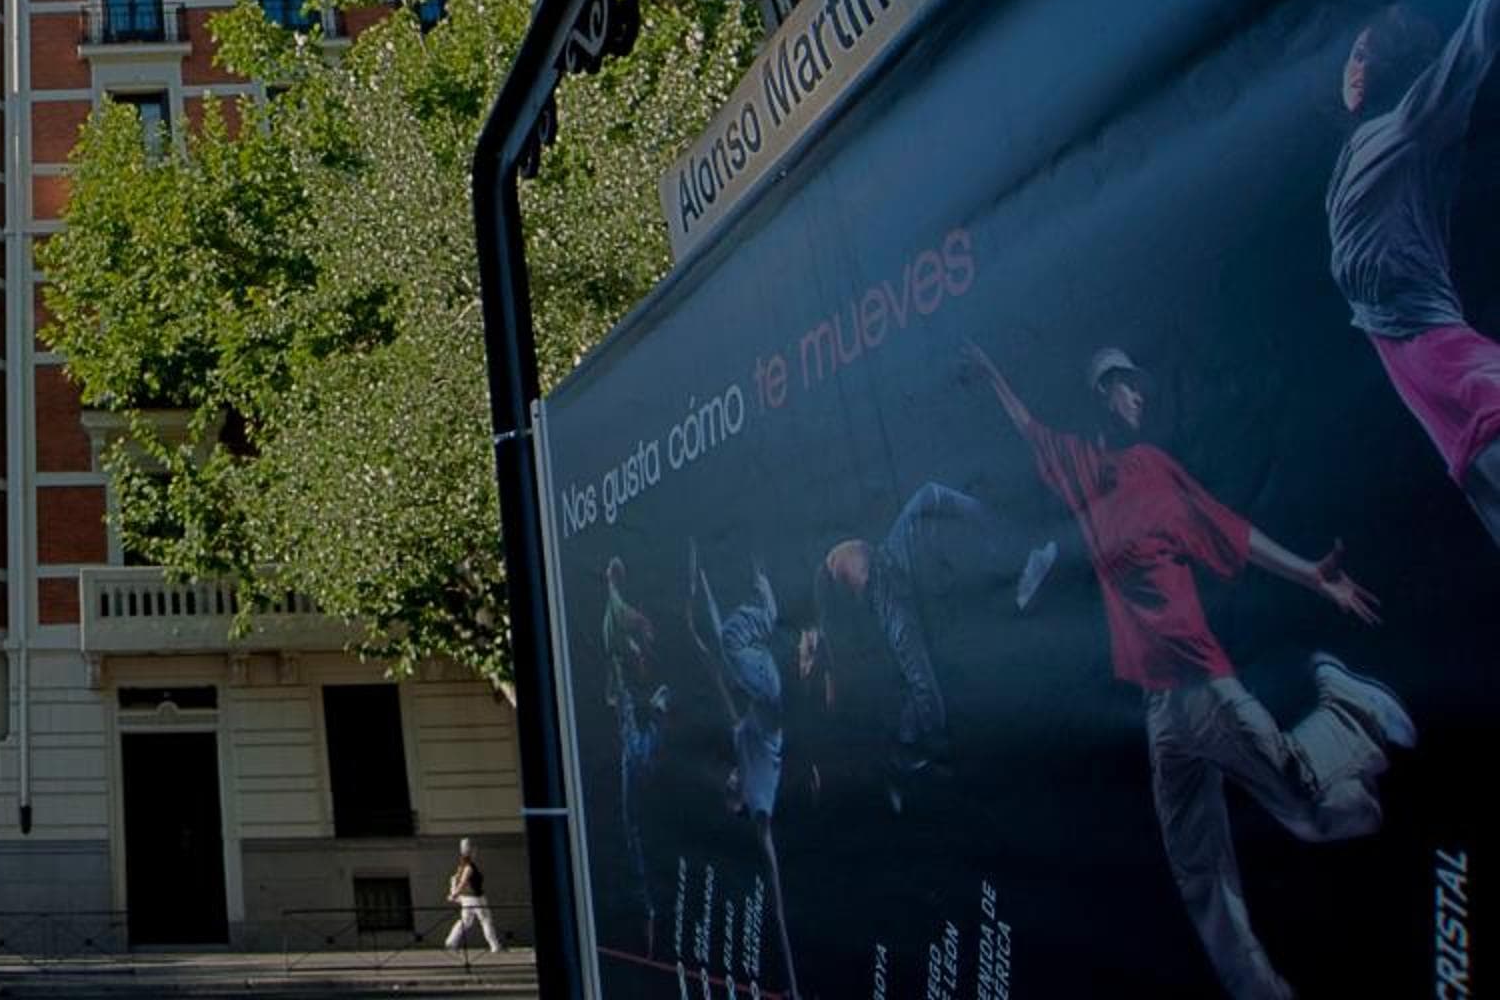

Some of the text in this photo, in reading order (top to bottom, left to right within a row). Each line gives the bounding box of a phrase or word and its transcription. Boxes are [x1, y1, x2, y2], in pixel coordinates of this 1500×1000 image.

[676, 103, 762, 233] Alonso
[561, 227, 976, 538] Nos gusta cómo te mueves
[980, 879, 997, 922] DE
